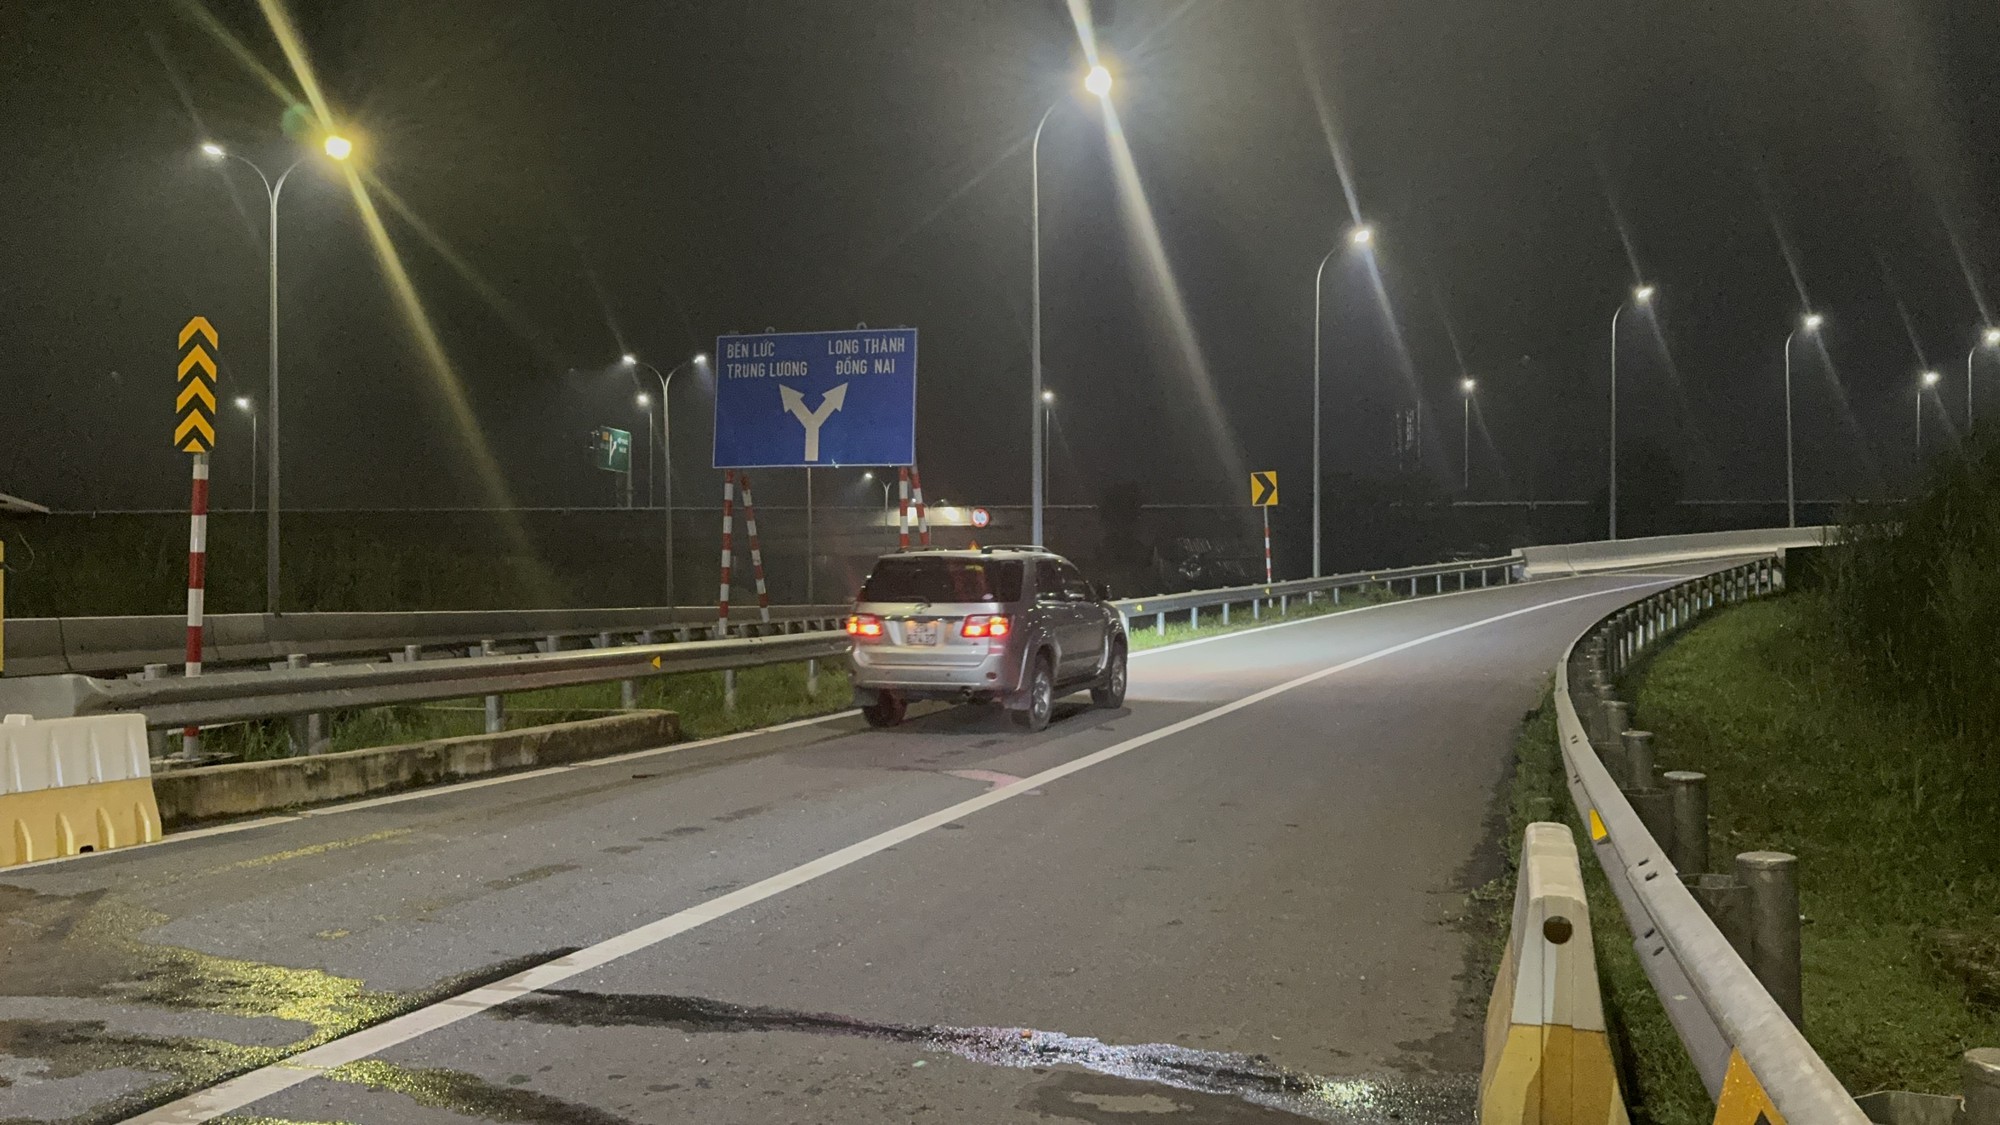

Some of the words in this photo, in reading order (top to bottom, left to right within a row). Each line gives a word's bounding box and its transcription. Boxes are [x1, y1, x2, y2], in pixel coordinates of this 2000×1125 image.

[727, 339, 749, 358] BẾN
[753, 338, 775, 357] LỨC
[828, 339, 860, 355] LONG
[864, 334, 905, 354] THÀNH
[727, 362, 765, 379] TRUNG
[769, 360, 808, 377] LƯƠNG
[874, 358, 895, 374] NAI
